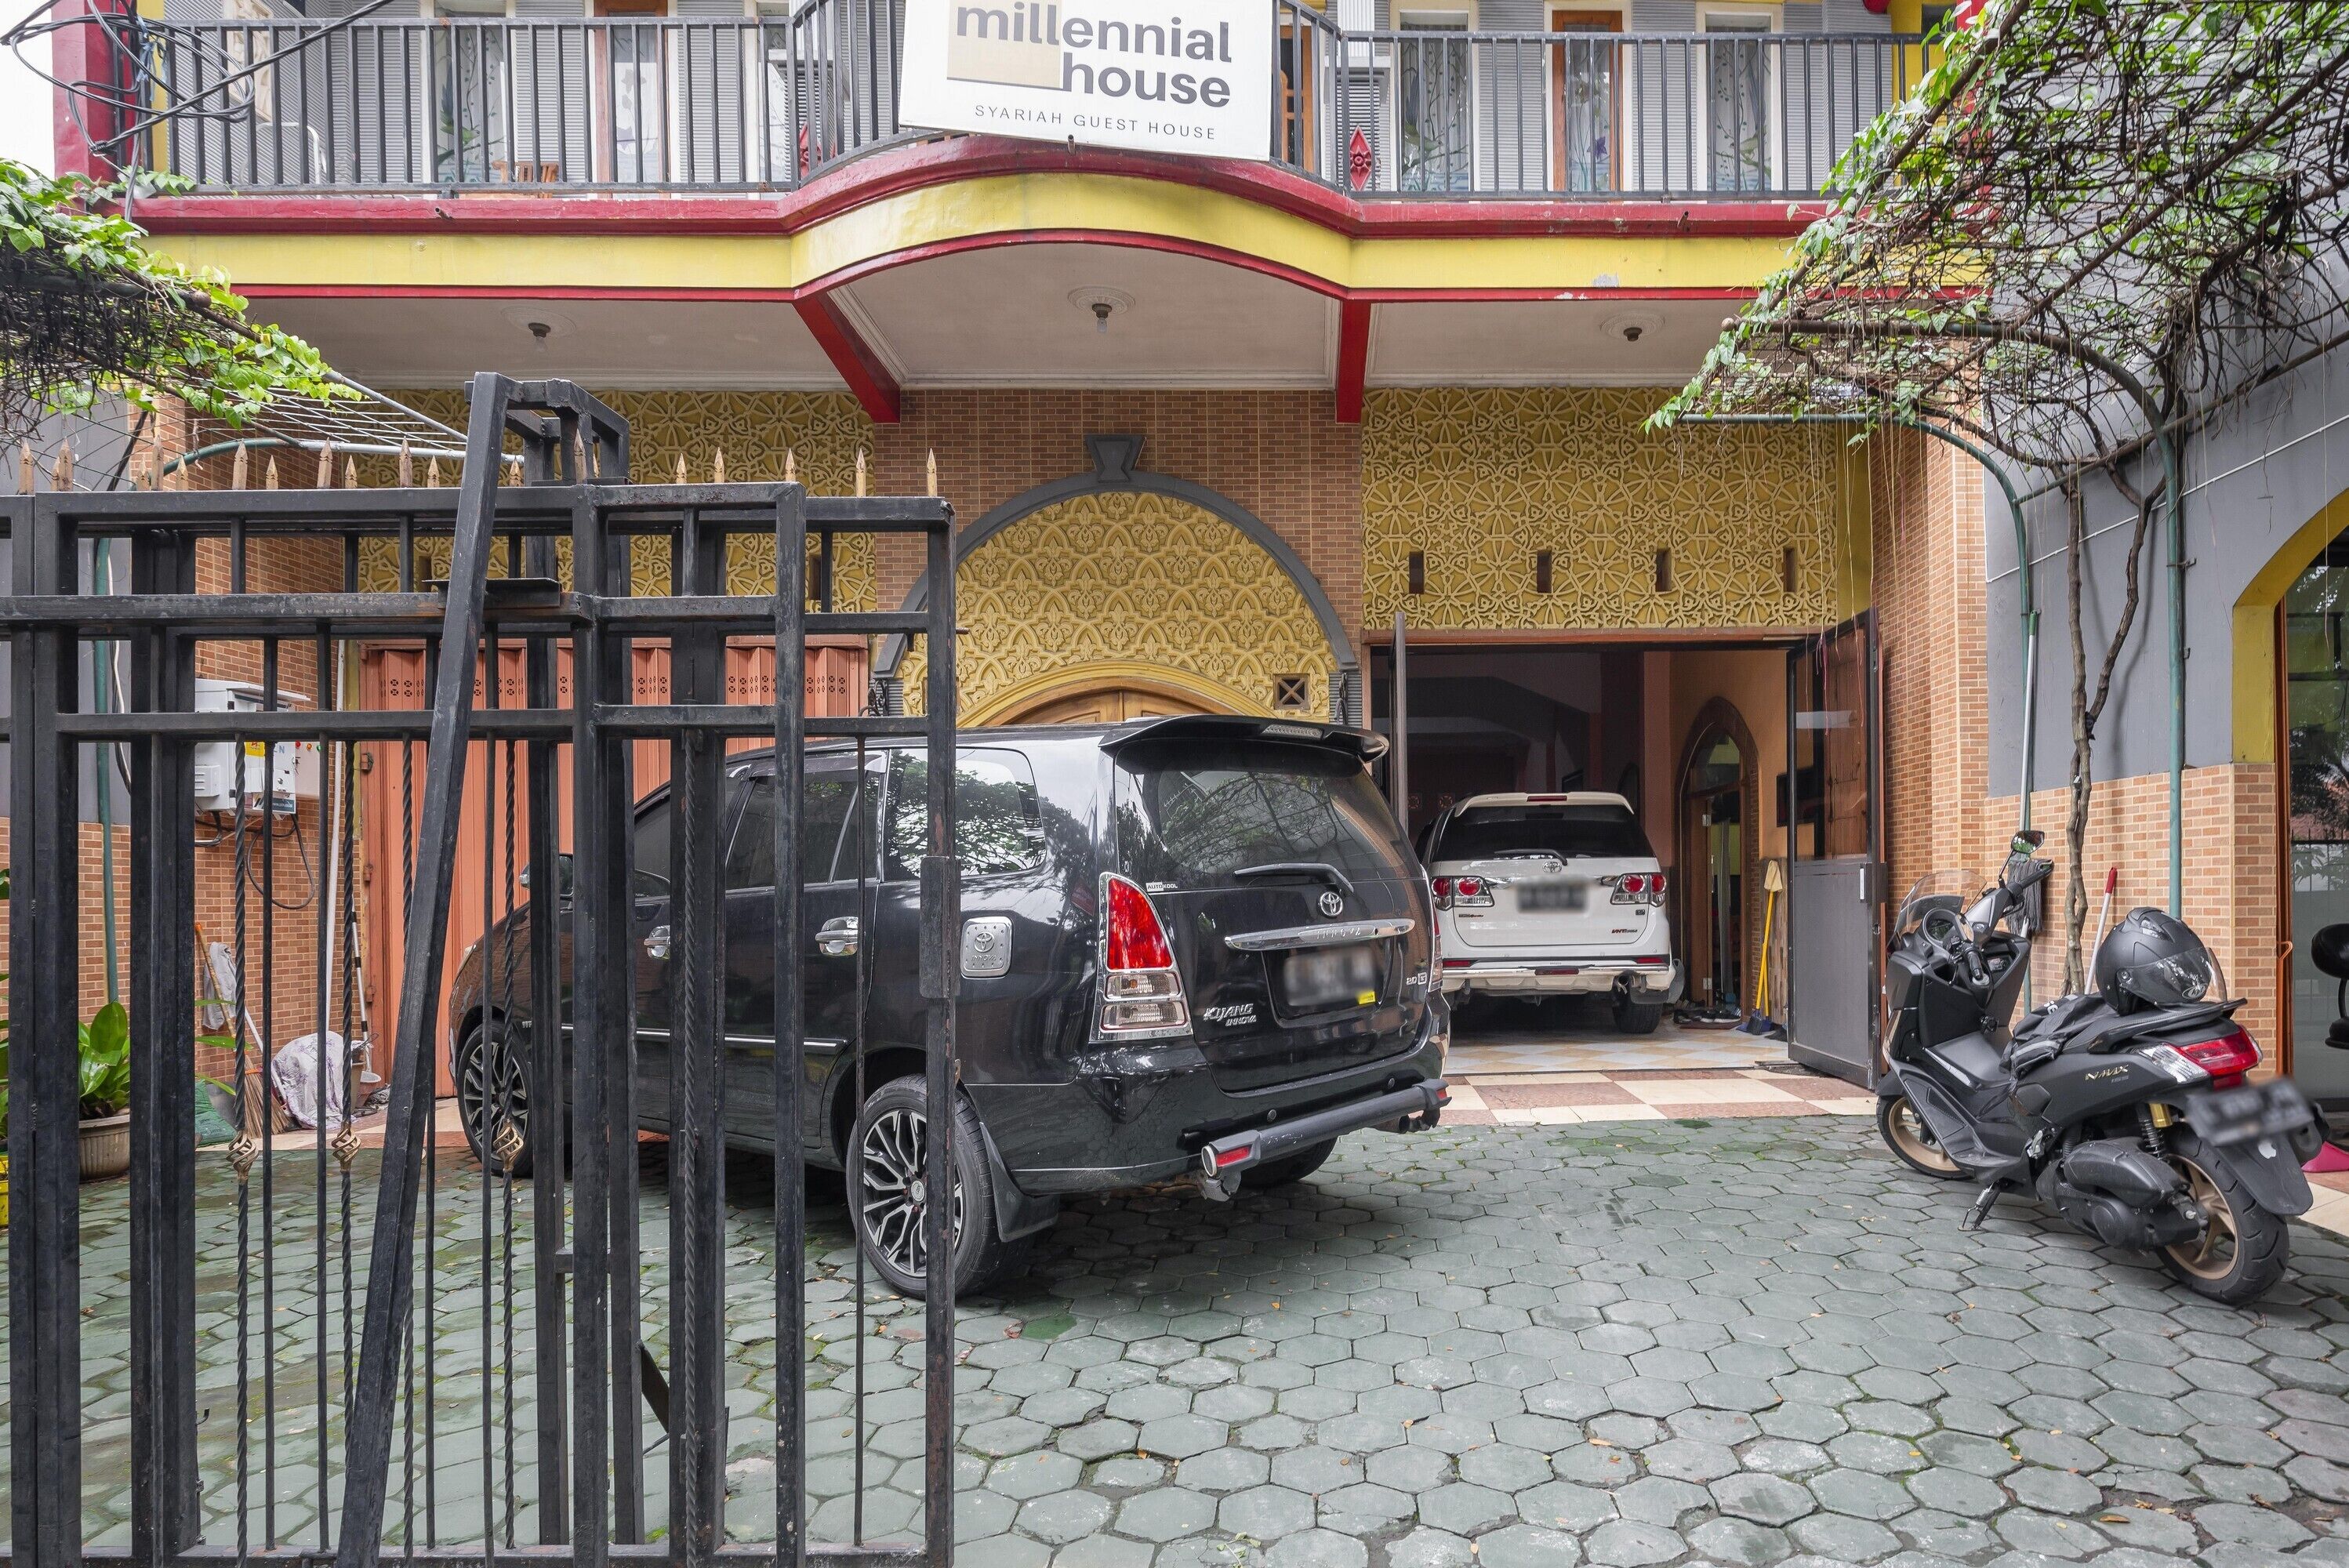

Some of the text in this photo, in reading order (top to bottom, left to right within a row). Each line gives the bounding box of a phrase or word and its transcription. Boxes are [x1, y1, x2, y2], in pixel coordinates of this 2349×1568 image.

[957, 2, 1232, 63] millennial
[1063, 52, 1230, 107] house
[975, 104, 1216, 140] SYARIAH GUEST HOUSE
[1203, 1004, 1254, 1022] KIJANG
[1225, 1014, 1257, 1027] INNOVA
